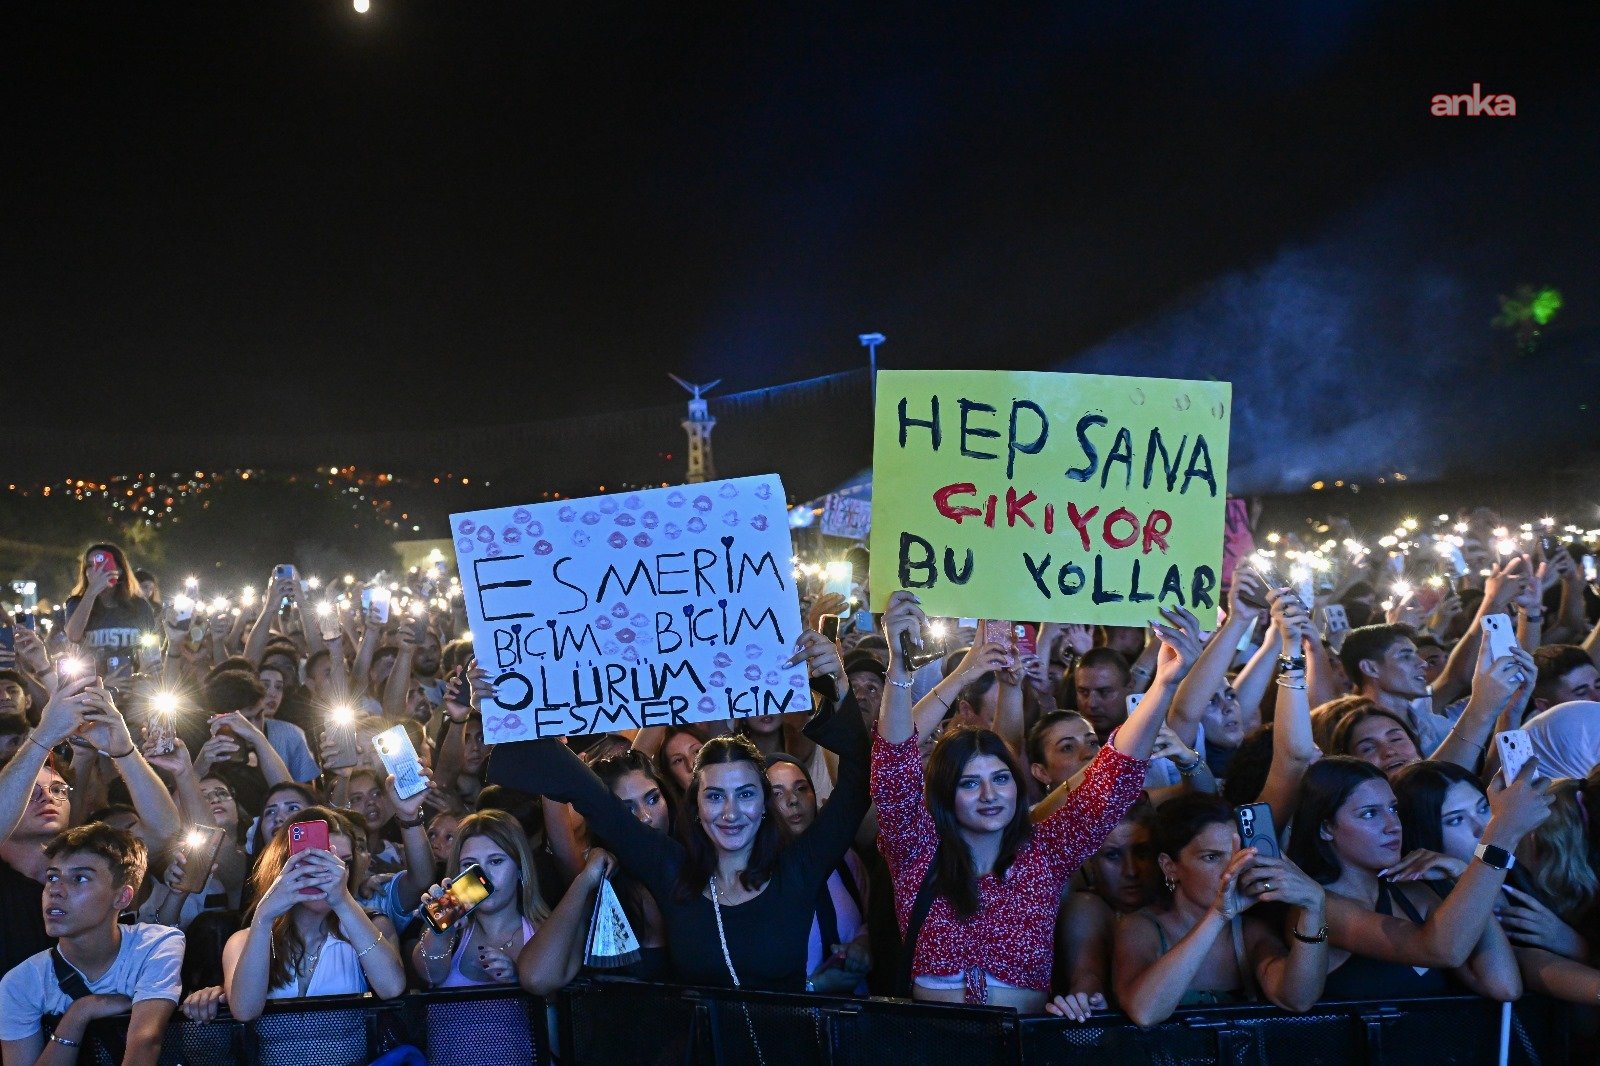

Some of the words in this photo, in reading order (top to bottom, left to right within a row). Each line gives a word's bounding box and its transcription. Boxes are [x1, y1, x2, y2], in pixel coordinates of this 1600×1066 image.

[898, 395, 1049, 480] HEP
[1065, 413, 1217, 497] SANA
[473, 535, 785, 621] ESMERİM
[898, 531, 974, 589] BU
[1023, 552, 1217, 609] YOLLAR
[493, 658, 707, 711] ÖLÜRÜM
[535, 696, 689, 739] ESMER
